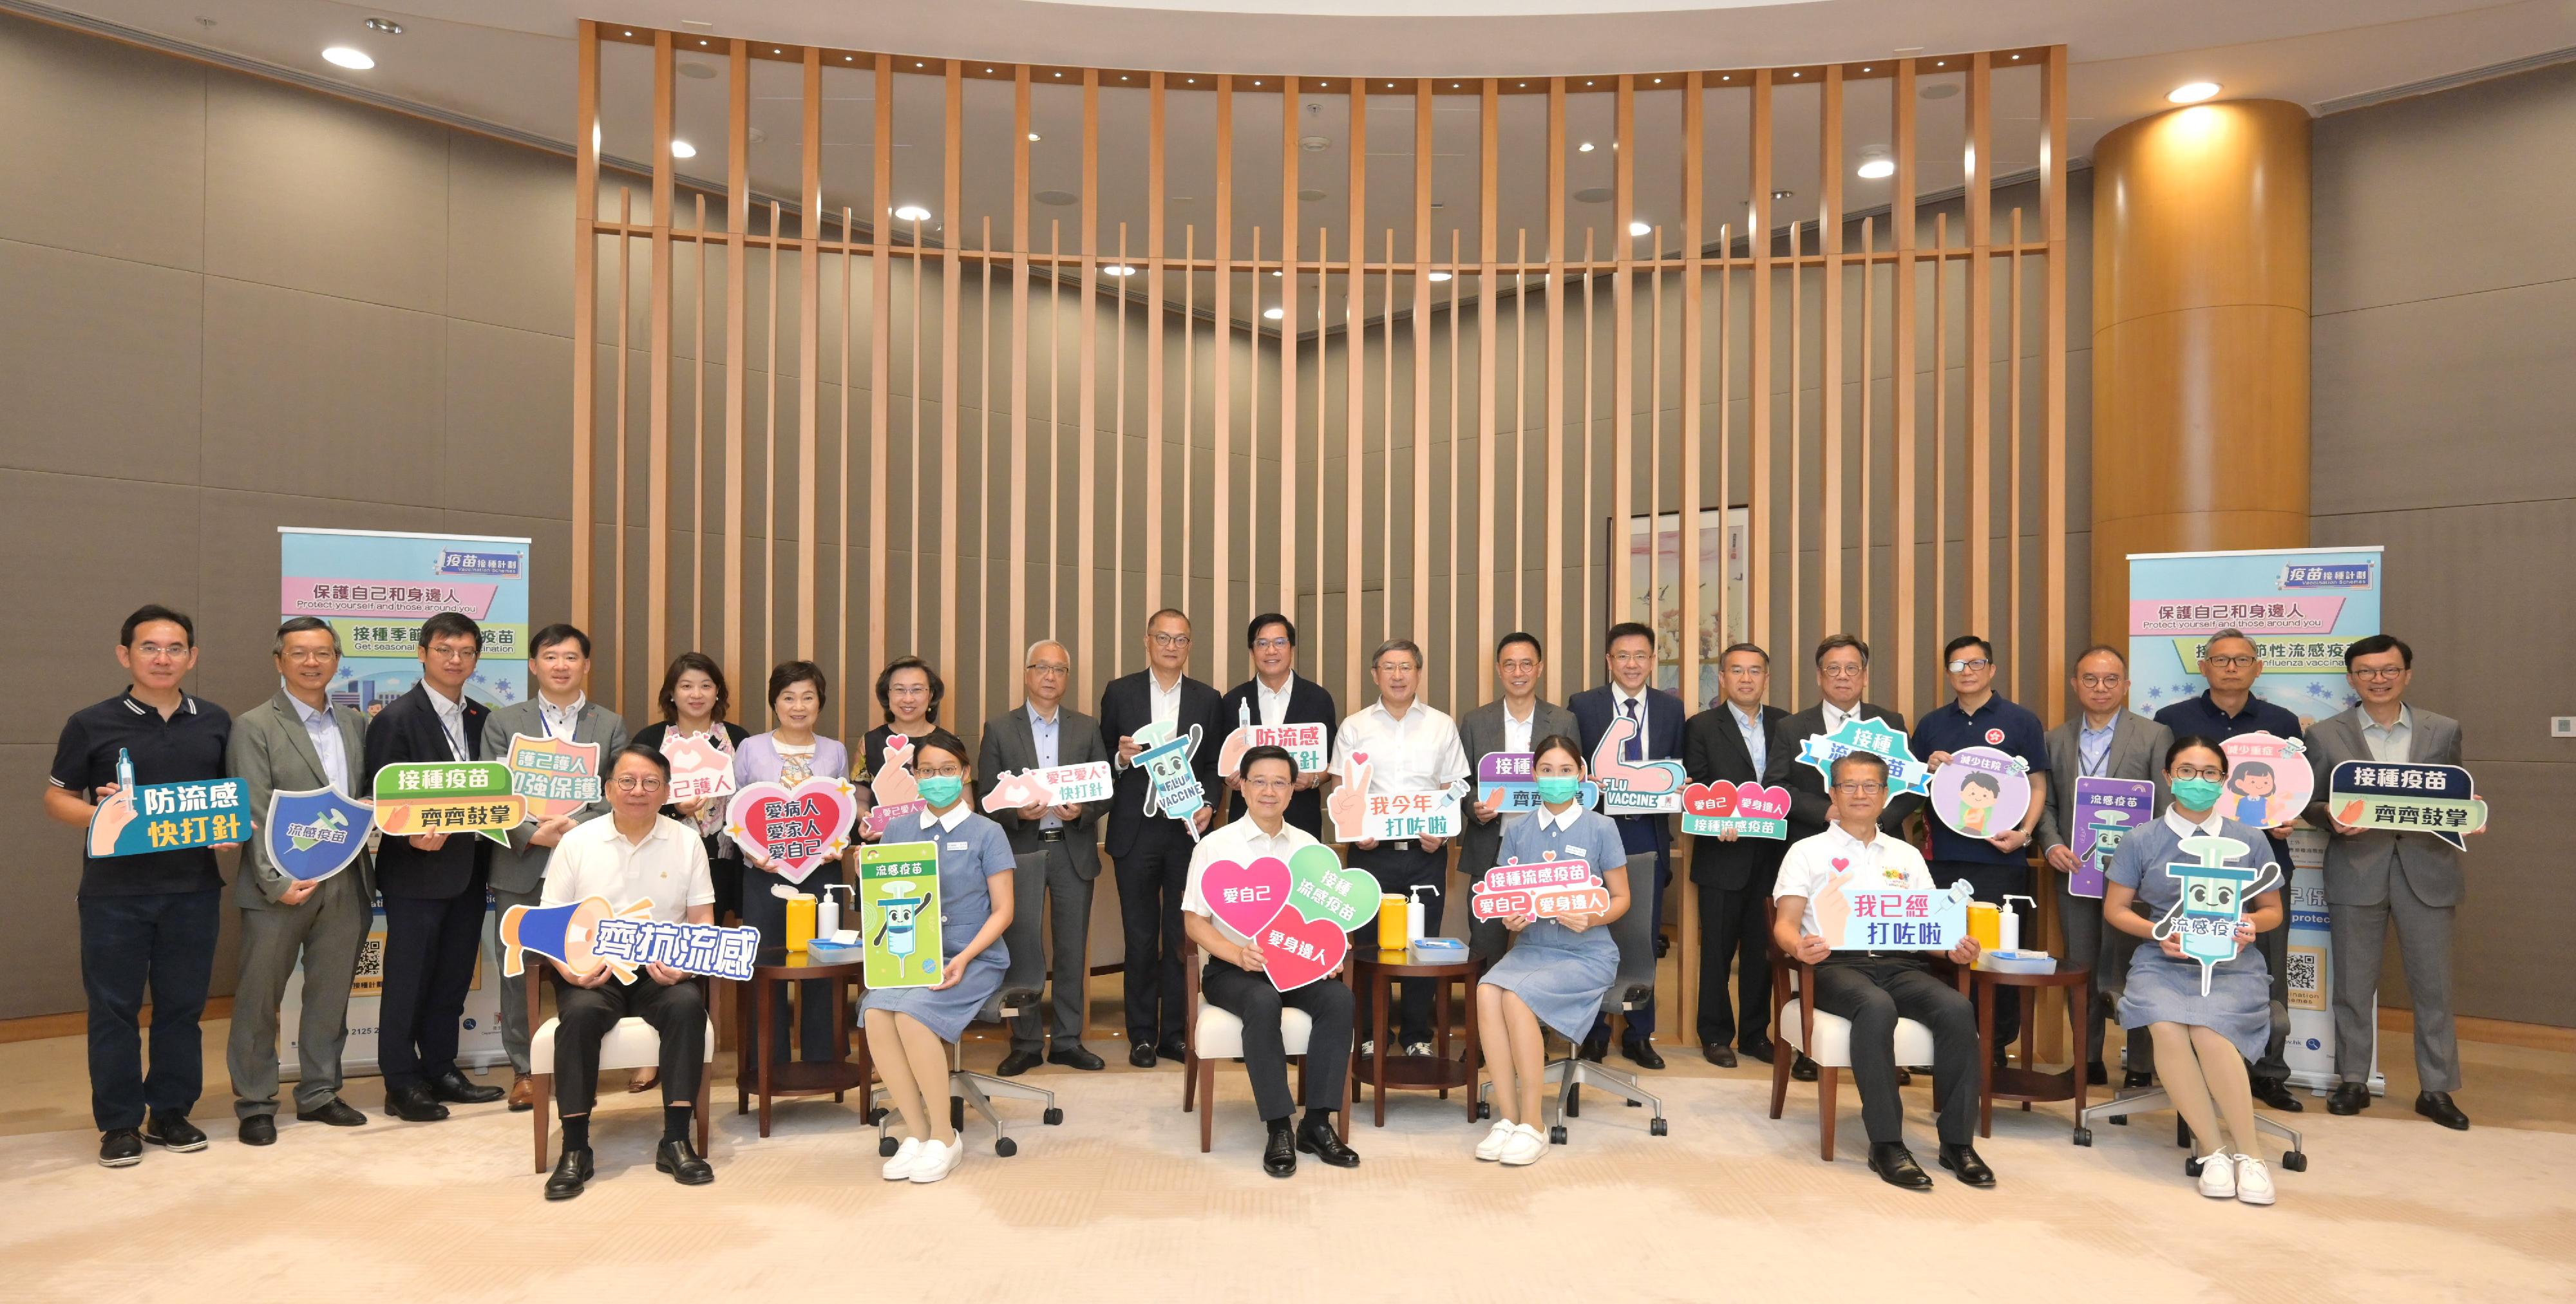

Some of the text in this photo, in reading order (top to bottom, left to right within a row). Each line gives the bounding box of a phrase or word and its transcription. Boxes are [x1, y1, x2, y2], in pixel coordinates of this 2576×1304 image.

[446, 554, 516, 569] 疫苗接種計劃
[2290, 567, 2366, 581] 疫苗接種計劃
[314, 585, 460, 604] 保護自己和身邊人
[298, 600, 332, 609] Protect
[376, 602, 394, 610] and
[2159, 603, 2304, 619] 保護自己和身邊人
[2179, 621, 2216, 629] yourself
[355, 643, 371, 651] Get
[374, 643, 415, 652] seasonal
[1256, 726, 1320, 746] 防流感
[1853, 728, 1893, 753] 接種
[2227, 745, 2274, 757] 減少重症
[517, 750, 587, 774] 護己護人
[1960, 754, 2002, 770] 減少住院
[398, 768, 489, 791] 接種疫苗
[1046, 766, 1102, 784] 愛己愛人
[1164, 775, 1186, 792] FLU
[1602, 778, 1628, 791] FLU
[2354, 766, 2447, 790] 接種疫苗
[144, 782, 239, 816] 防流感
[1059, 785, 1103, 801] 快打針
[1159, 784, 1204, 809] VACCINE
[1608, 792, 1658, 807] VACCINE
[2090, 795, 2138, 808] 流感疫苗
[765, 798, 820, 820] 愛病人
[882, 803, 918, 817] 愛己愛人
[1370, 794, 1433, 816] 我今年
[1694, 797, 1727, 811] 愛自己
[1741, 797, 1783, 815] 愛身邊人
[421, 805, 510, 827] 齊齊鼓掌
[2375, 804, 2468, 827] 齊齊鼓掌
[147, 813, 241, 848] 快打針
[287, 822, 348, 844] 流感疫苗
[766, 820, 822, 840] 愛家人
[1386, 816, 1448, 837] 打咗啦
[768, 839, 823, 861] 愛自己
[875, 862, 923, 876] 流感疫苗
[1490, 864, 1585, 888] 接種流感疫苗
[1321, 869, 1354, 898] 接種
[1223, 885, 1271, 904] 愛自己
[1296, 878, 1357, 921] 流感疫苗
[1480, 895, 1526, 914] 愛自己
[1539, 891, 1605, 913] 愛身邊人
[1854, 894, 1929, 918] 我已經
[1868, 921, 1942, 945] 打咗啦
[594, 920, 757, 978] 齊抗流感
[1267, 929, 1327, 966] 愛身邊人
